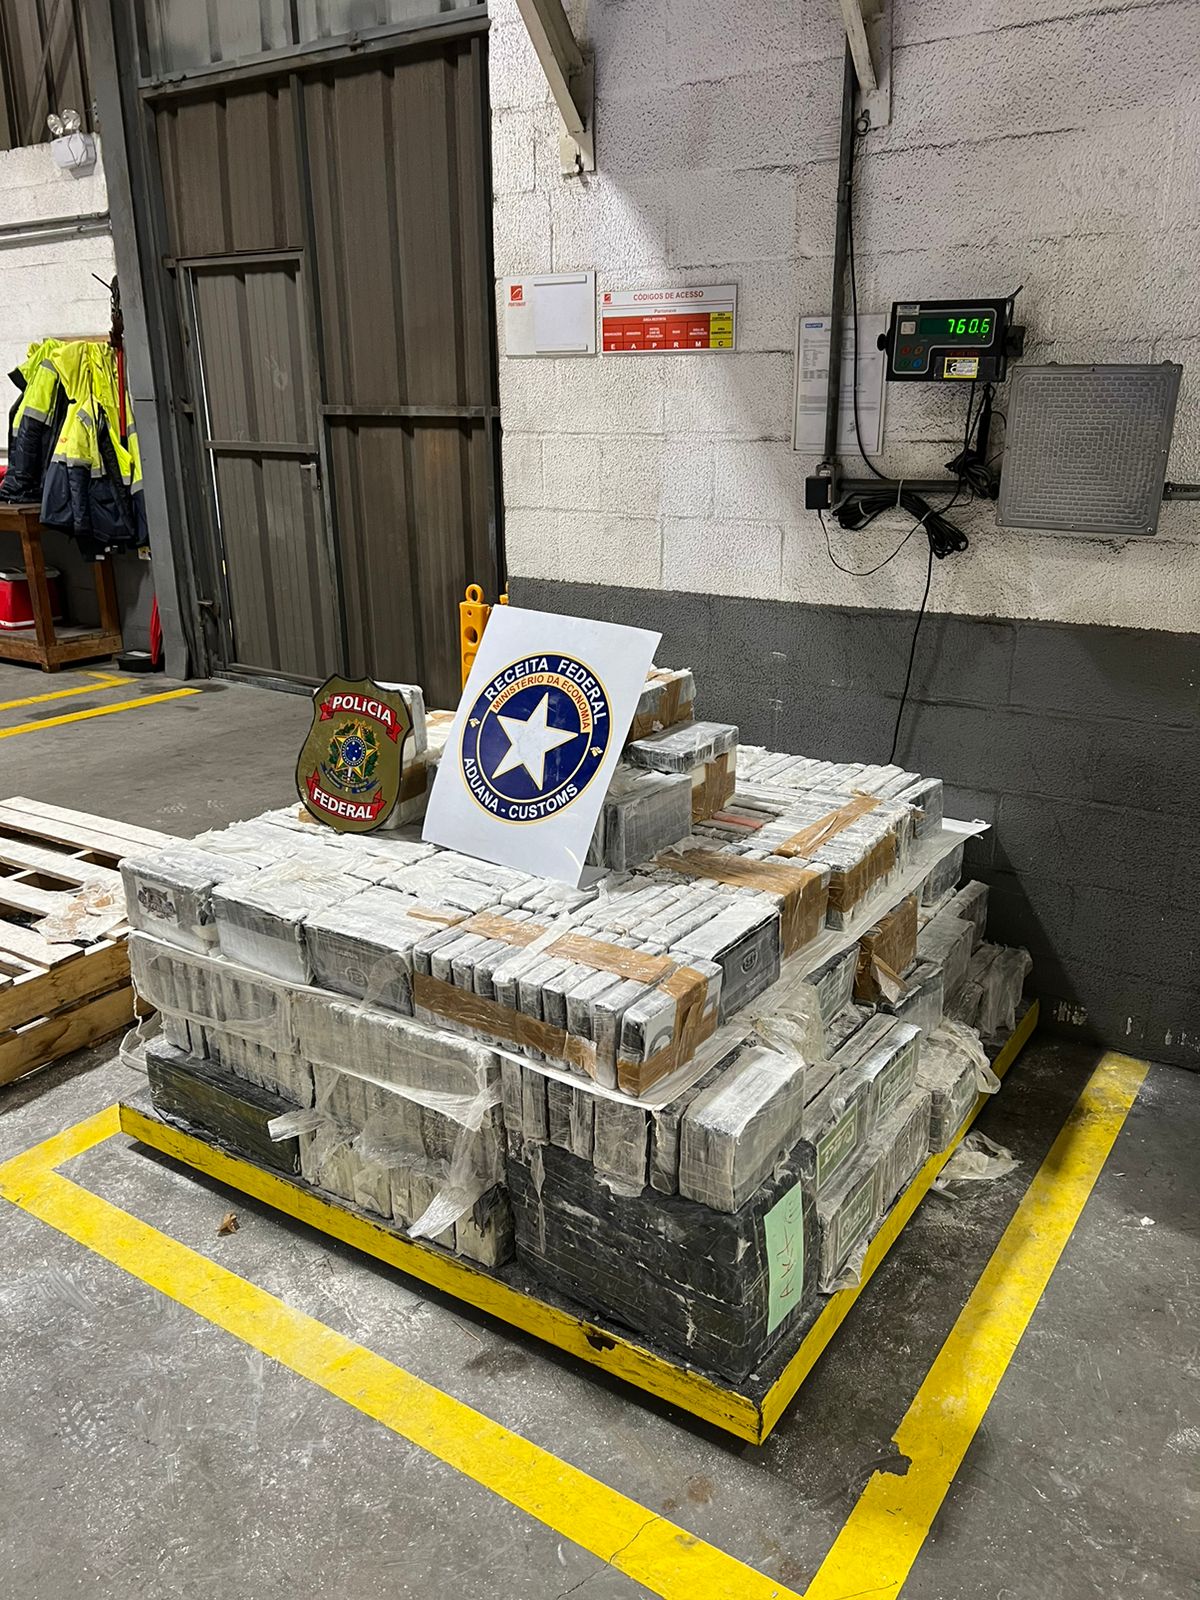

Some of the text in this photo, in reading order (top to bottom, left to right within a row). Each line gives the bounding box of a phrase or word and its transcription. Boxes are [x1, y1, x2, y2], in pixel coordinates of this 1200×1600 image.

[633, 290, 704, 301] CÓDIGOS DE ACESSO
[948, 318, 991, 334] 760.6
[483, 656, 607, 725] RECEITA FEDERAL
[491, 674, 590, 731] MINISTÉRIO DA ECONOMIA
[313, 787, 374, 819] FEDERAL
[463, 758, 499, 815] ADUANA
[508, 783, 578, 820] CUSTOMS
